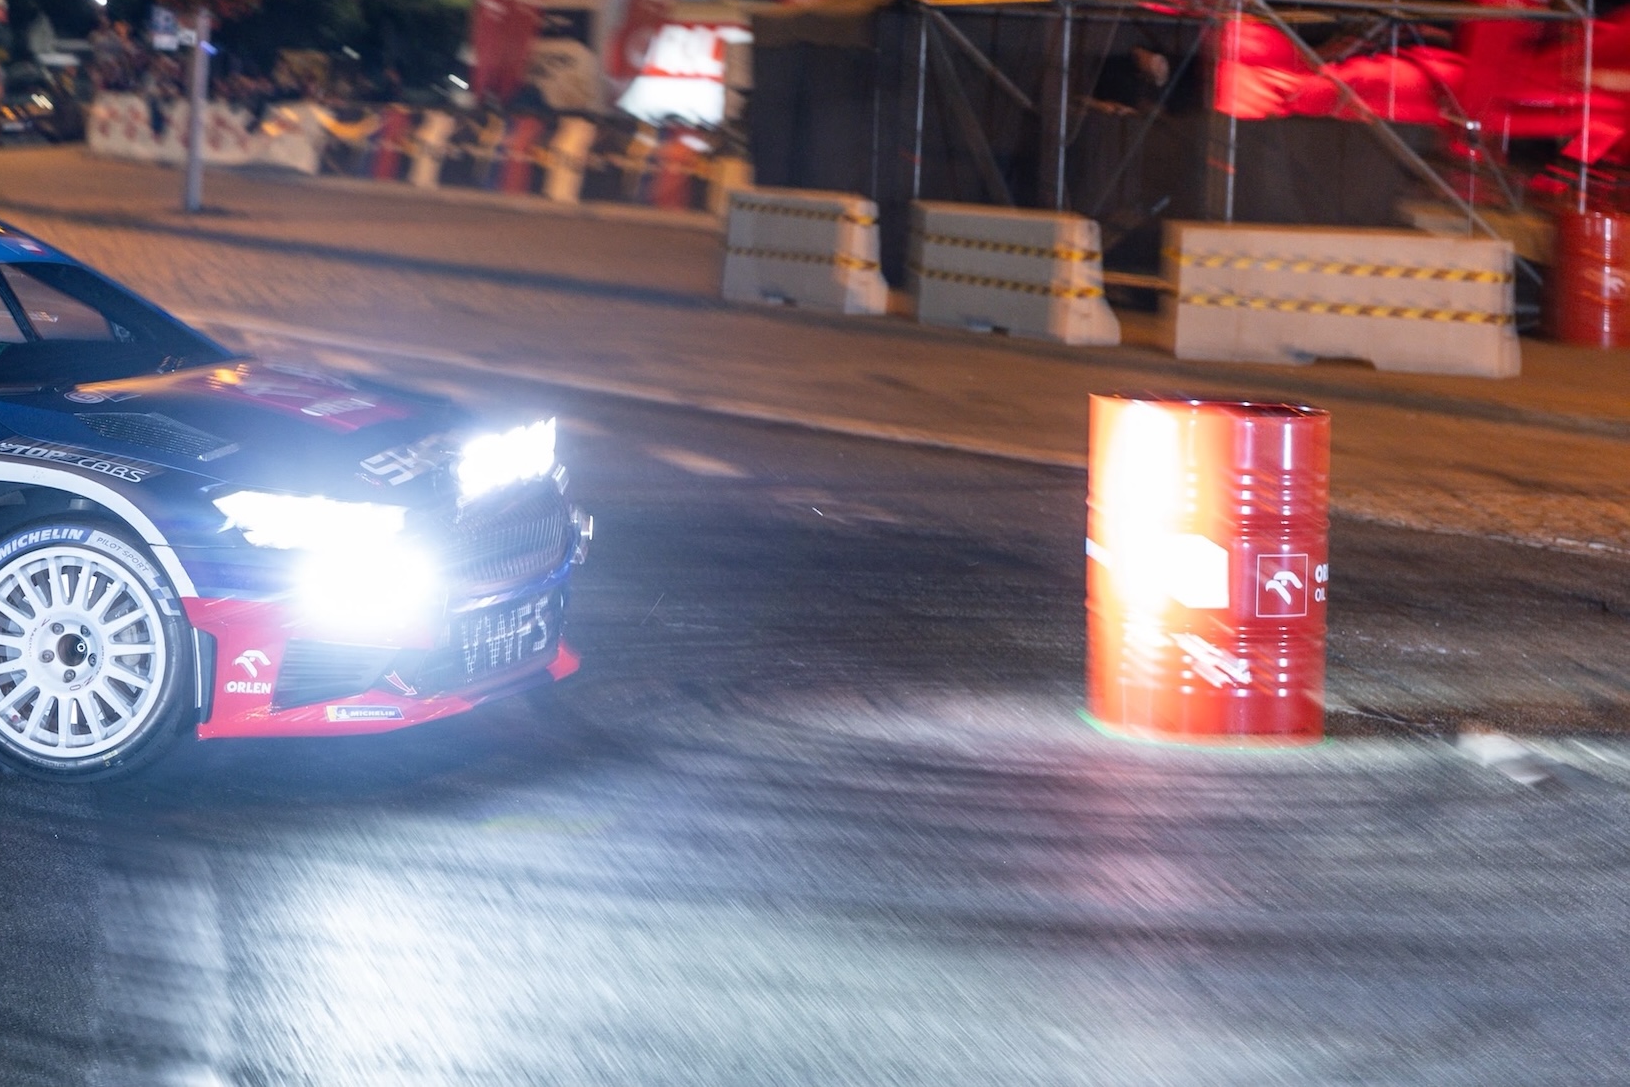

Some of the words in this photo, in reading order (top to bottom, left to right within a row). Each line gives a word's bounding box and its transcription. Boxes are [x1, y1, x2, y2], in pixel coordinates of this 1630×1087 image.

[96, 536, 122, 552] PILOT
[121, 549, 149, 573] SPORT
[226, 680, 272, 694] ORLEN
